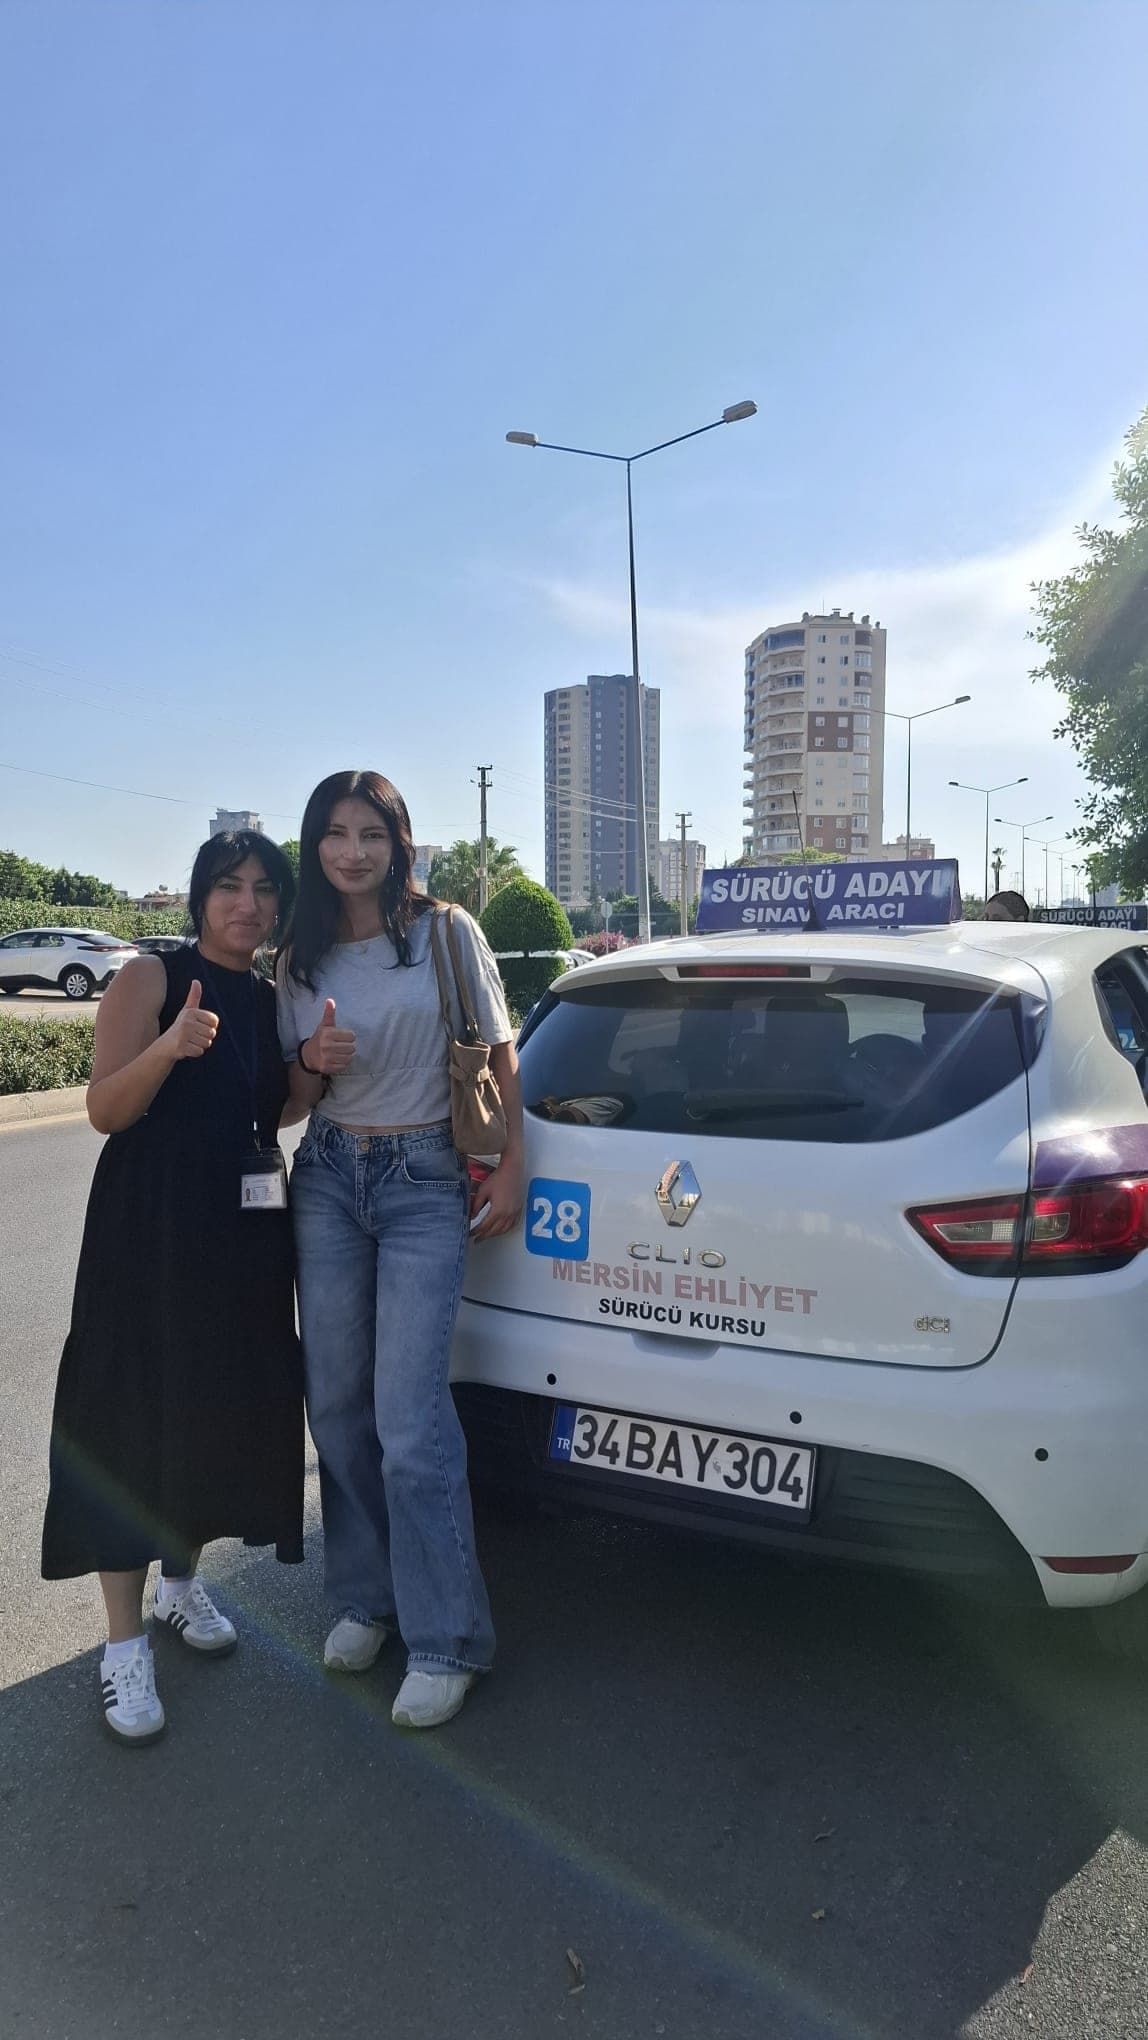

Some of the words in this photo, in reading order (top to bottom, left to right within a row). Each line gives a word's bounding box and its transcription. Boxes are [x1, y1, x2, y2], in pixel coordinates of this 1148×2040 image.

[711, 869, 835, 903] SÜRÜCÜ
[843, 869, 942, 898] ADAYI
[741, 907, 810, 923] SINAV
[826, 903, 905, 920] ARACI
[1098, 906, 1137, 921] ADAYI
[531, 1197, 581, 1243] 28
[626, 1240, 726, 1268] CLIO
[552, 1258, 662, 1296] MERSİN
[674, 1274, 818, 1314] EHLİYET
[598, 1297, 682, 1325] SÜRÜCÜ
[689, 1311, 766, 1337] KURSU
[557, 1437, 571, 1450] TR
